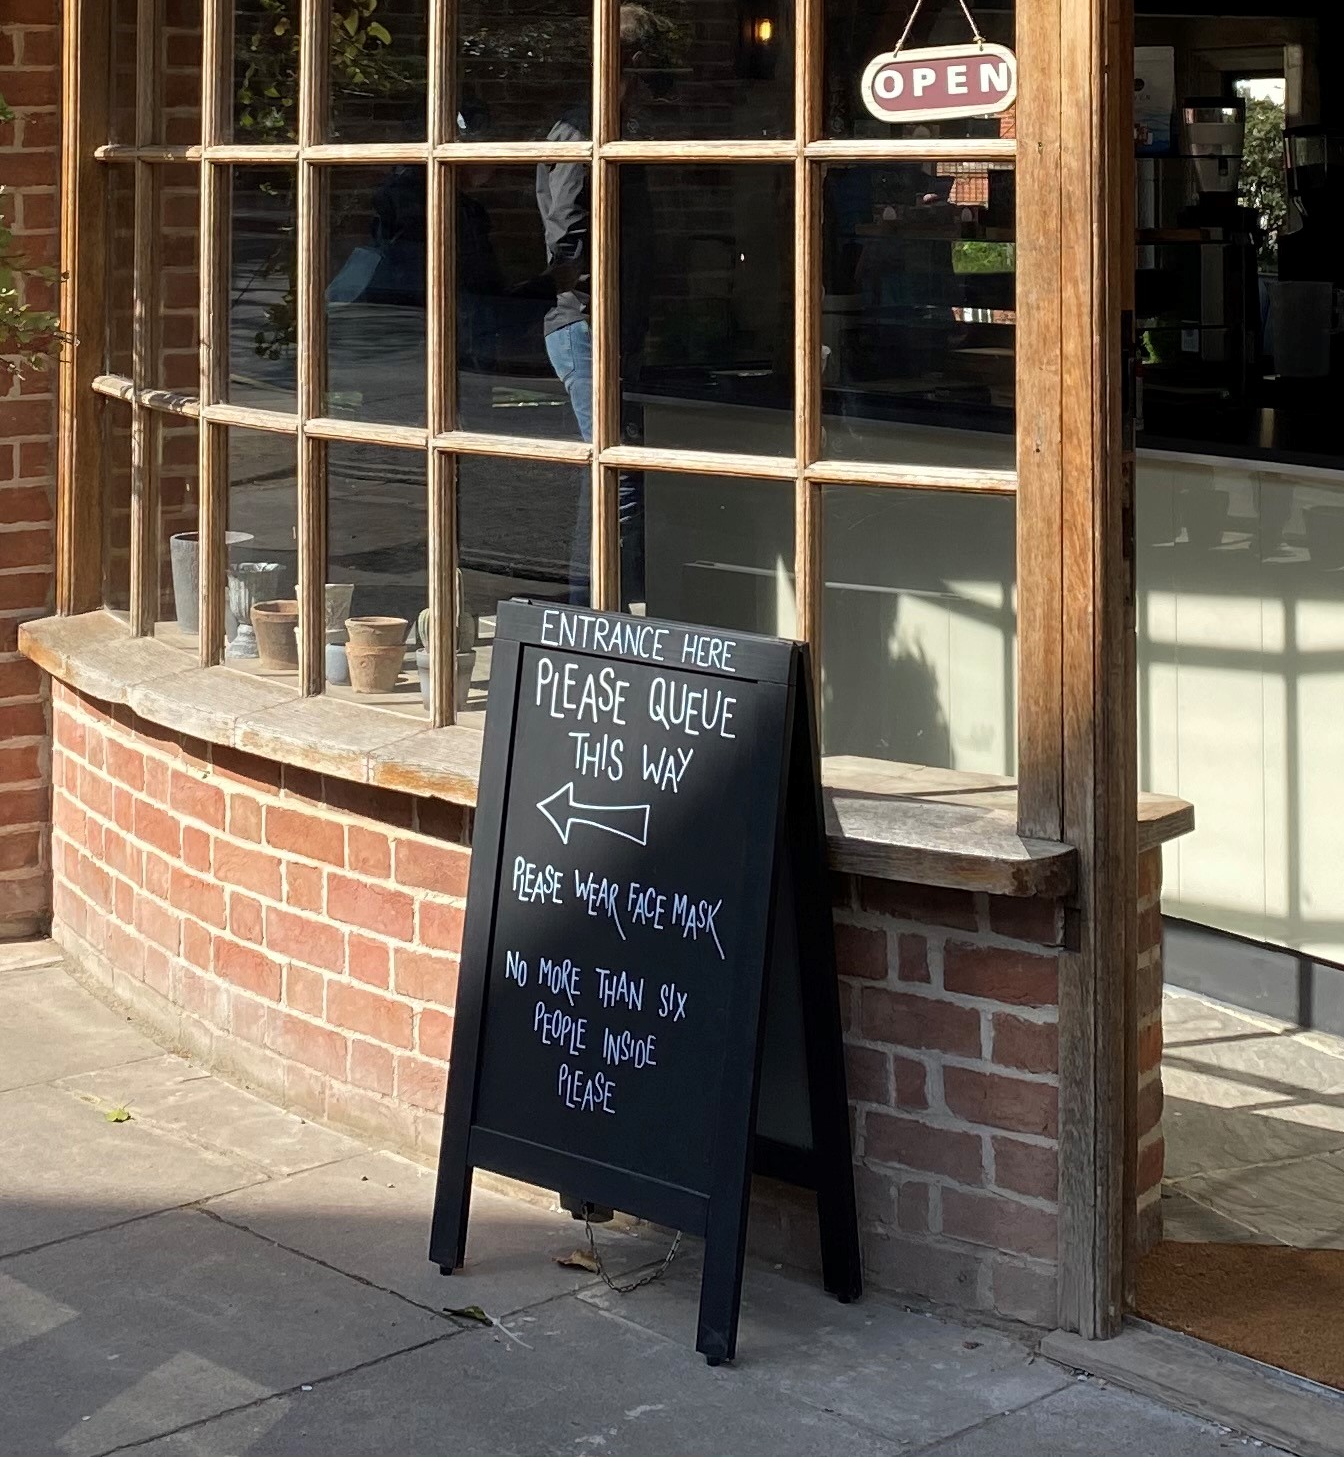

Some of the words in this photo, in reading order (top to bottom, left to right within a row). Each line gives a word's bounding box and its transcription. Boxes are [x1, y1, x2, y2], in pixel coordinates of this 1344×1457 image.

[874, 62, 1008, 99] OPEN
[540, 609, 669, 662] ENTRANCE
[681, 634, 737, 673] HERE
[536, 657, 630, 725] PLEASE
[648, 676, 737, 738] QUEUE
[568, 730, 624, 781] THIS
[643, 744, 693, 793] WAY
[513, 855, 563, 904] PLEASE
[575, 869, 626, 940] WEAR
[628, 883, 666, 929] FACE
[672, 894, 724, 959] MASK
[506, 951, 527, 986] NO
[539, 958, 580, 1006] MORE
[596, 968, 643, 1010] THAN
[659, 984, 687, 1021] SIX
[534, 1002, 587, 1055] PEOPLE
[603, 1028, 656, 1068] INSIDE
[559, 1064, 615, 1113] PLEASE
